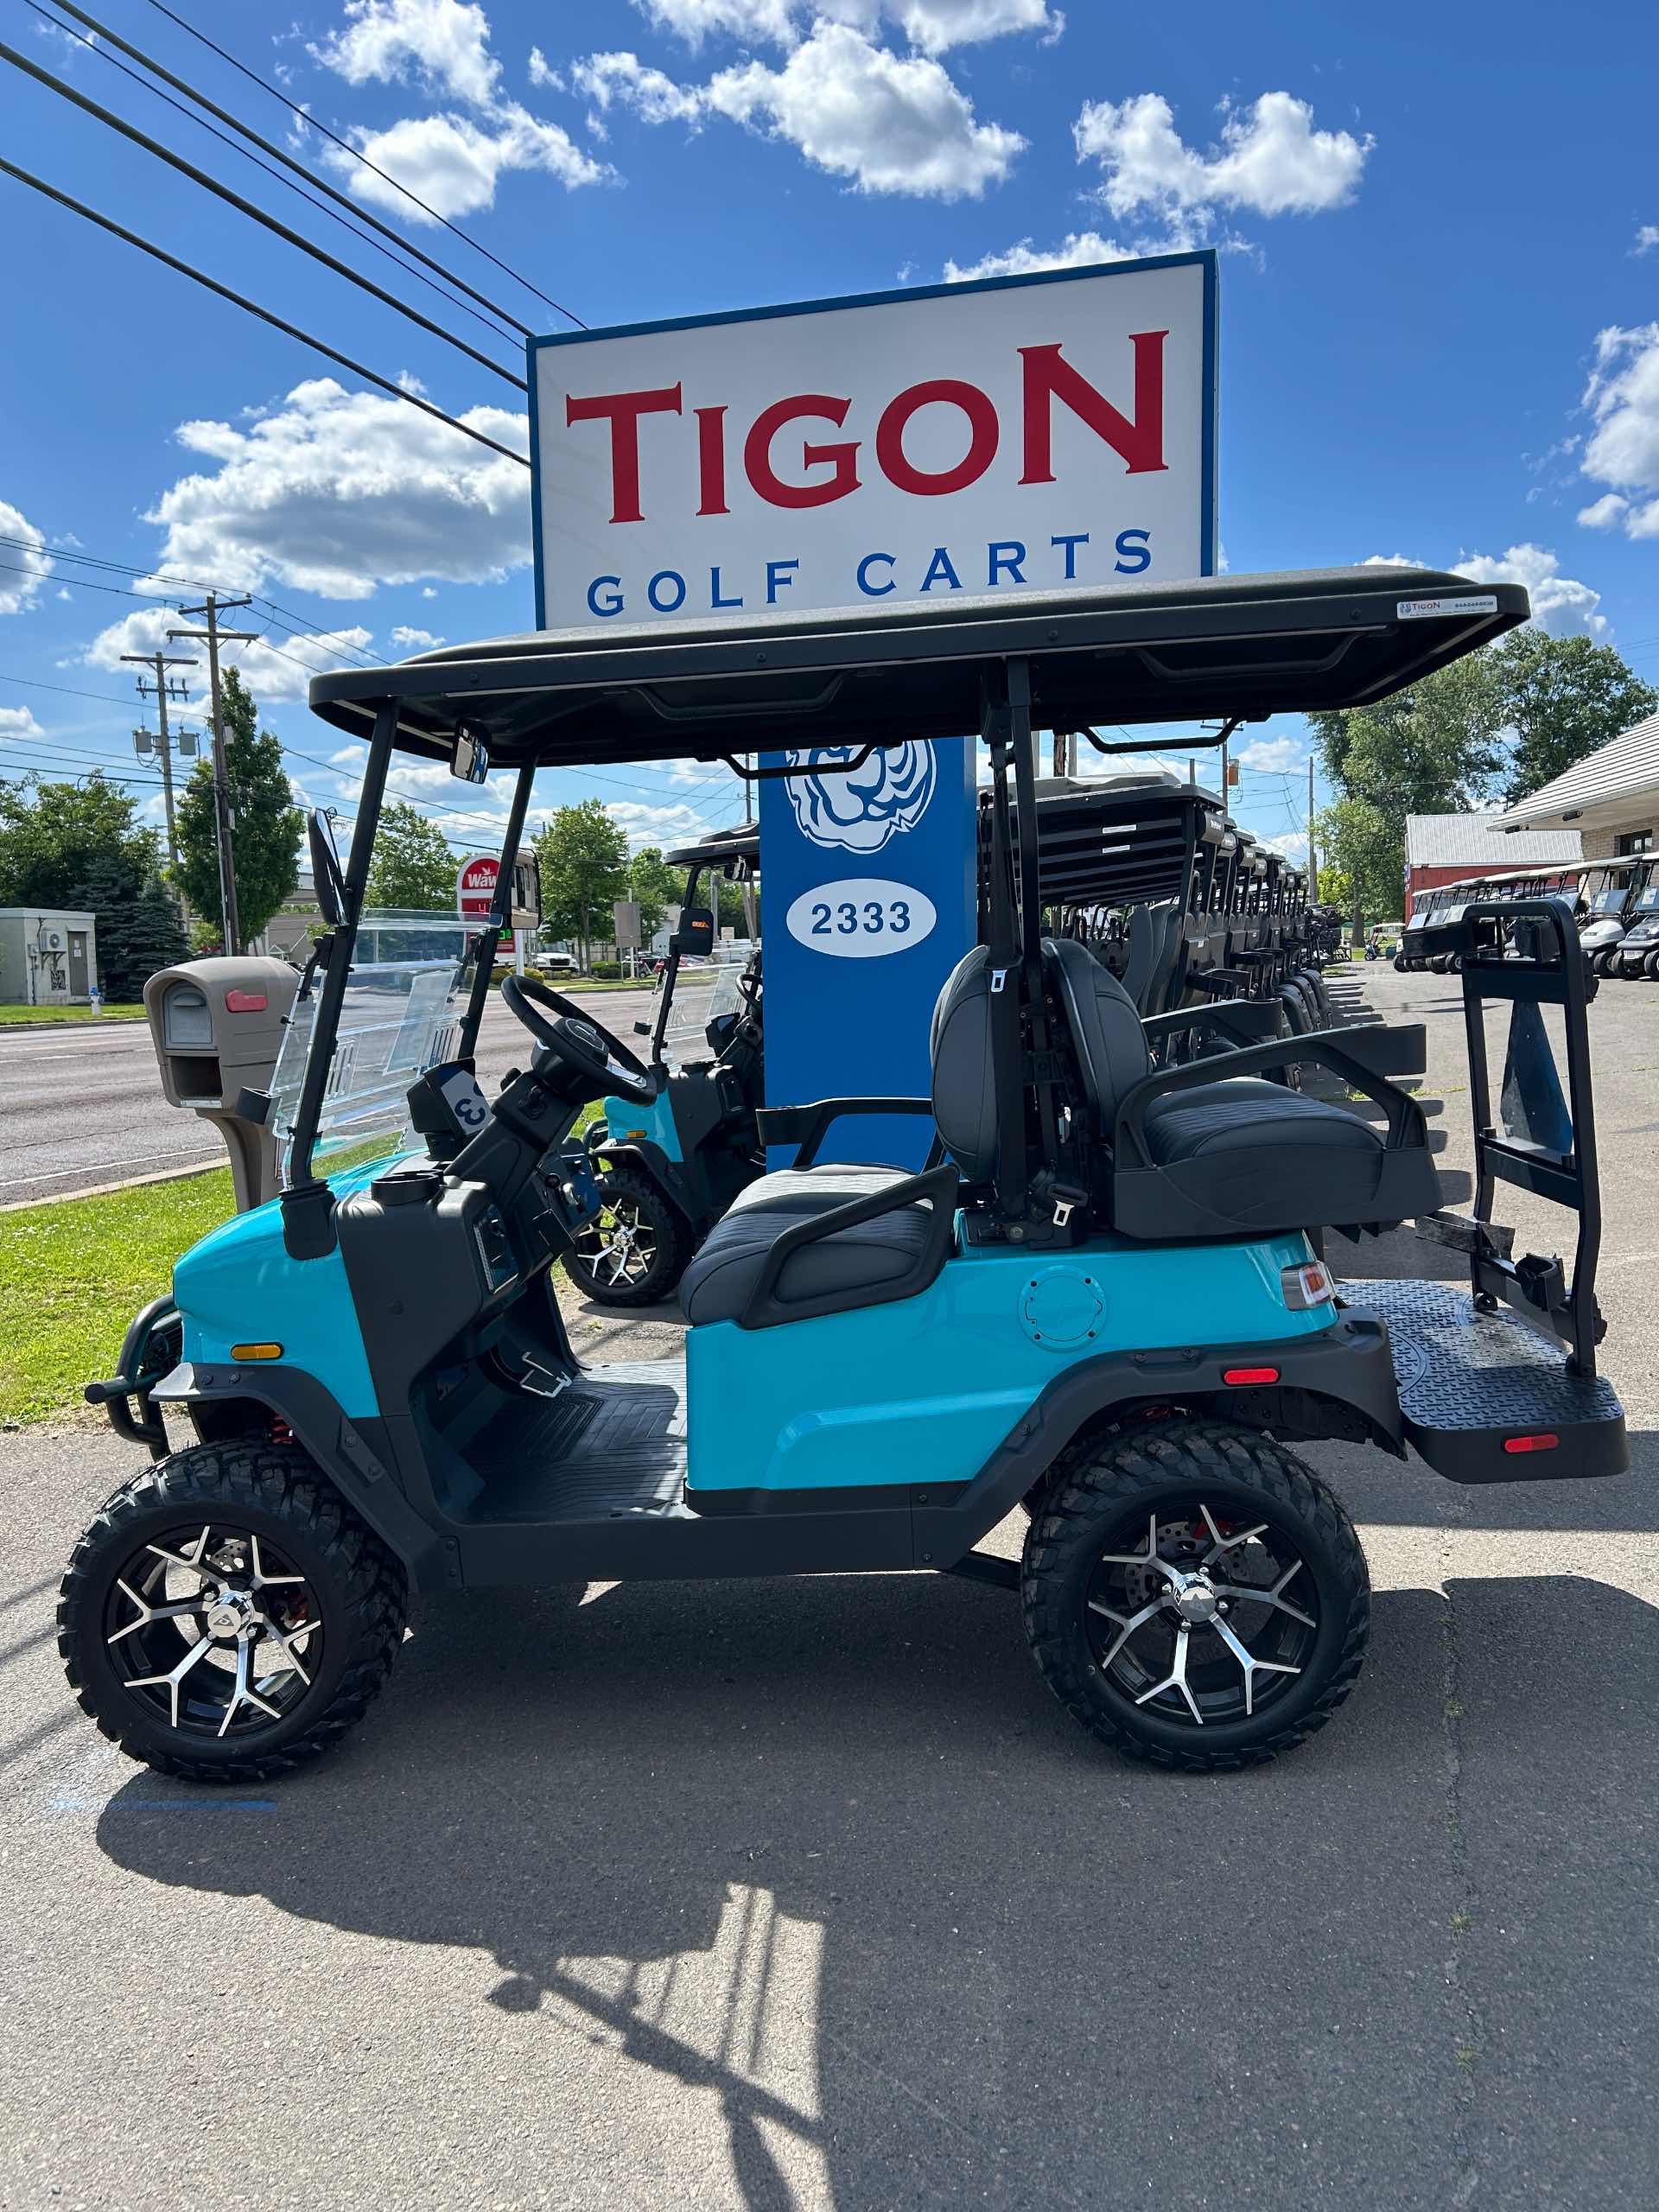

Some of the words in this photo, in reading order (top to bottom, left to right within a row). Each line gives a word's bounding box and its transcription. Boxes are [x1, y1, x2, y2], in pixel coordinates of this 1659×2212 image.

[566, 330, 1169, 524] TIGON
[587, 558, 799, 618] GOLF
[856, 529, 1152, 596] CARTS
[1413, 601, 1440, 610] TIGON
[467, 874, 498, 887] Waw
[811, 901, 911, 934] 2333
